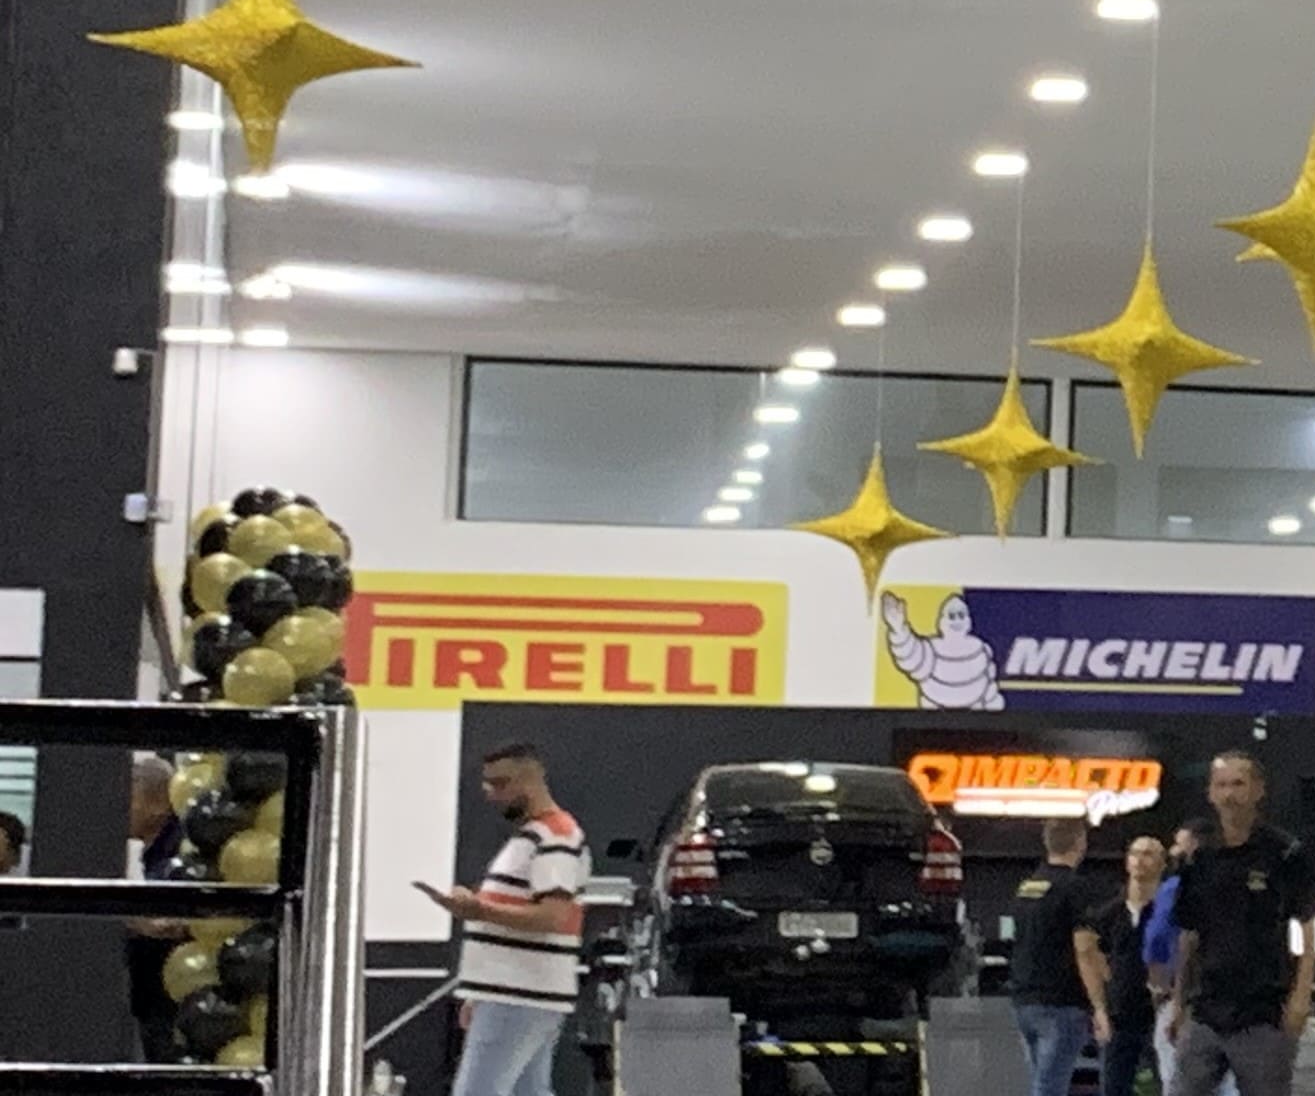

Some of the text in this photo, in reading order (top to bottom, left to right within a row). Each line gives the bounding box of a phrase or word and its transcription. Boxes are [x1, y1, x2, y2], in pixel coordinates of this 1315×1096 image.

[345, 592, 765, 695] PIRELLI
[1005, 637, 1303, 682] MICHELIN
[956, 756, 1162, 791] IMPACTO
